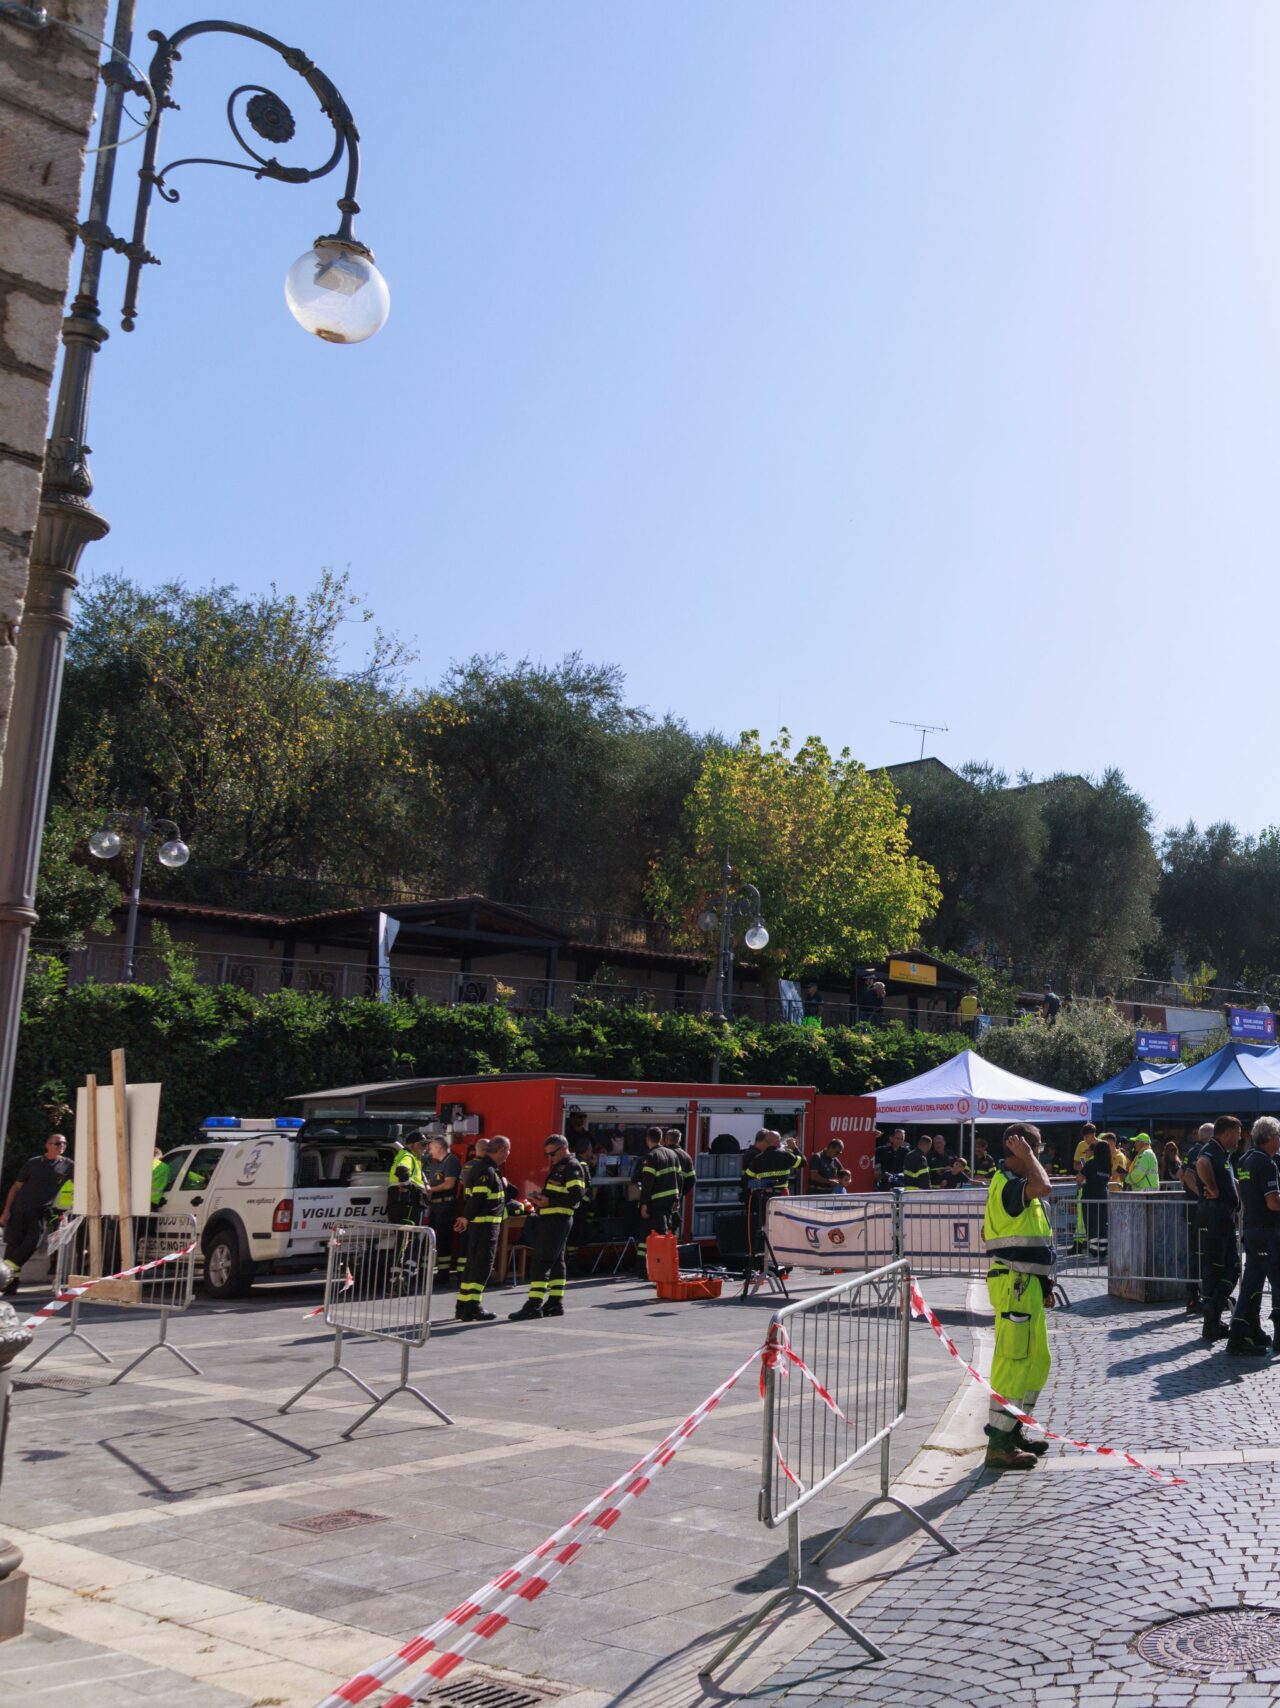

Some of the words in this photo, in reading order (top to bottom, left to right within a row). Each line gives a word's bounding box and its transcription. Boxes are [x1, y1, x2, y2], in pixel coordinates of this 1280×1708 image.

[876, 1104, 901, 1113] AZIONALE
[911, 1104, 925, 1112] VIGILI
[1007, 1104, 1032, 1112] NAZIONALE
[830, 1116, 864, 1132] VIGILI
[302, 1207, 341, 1219] VIGILI
[344, 1206, 368, 1217] DEL
[372, 1205, 388, 1216] FU
